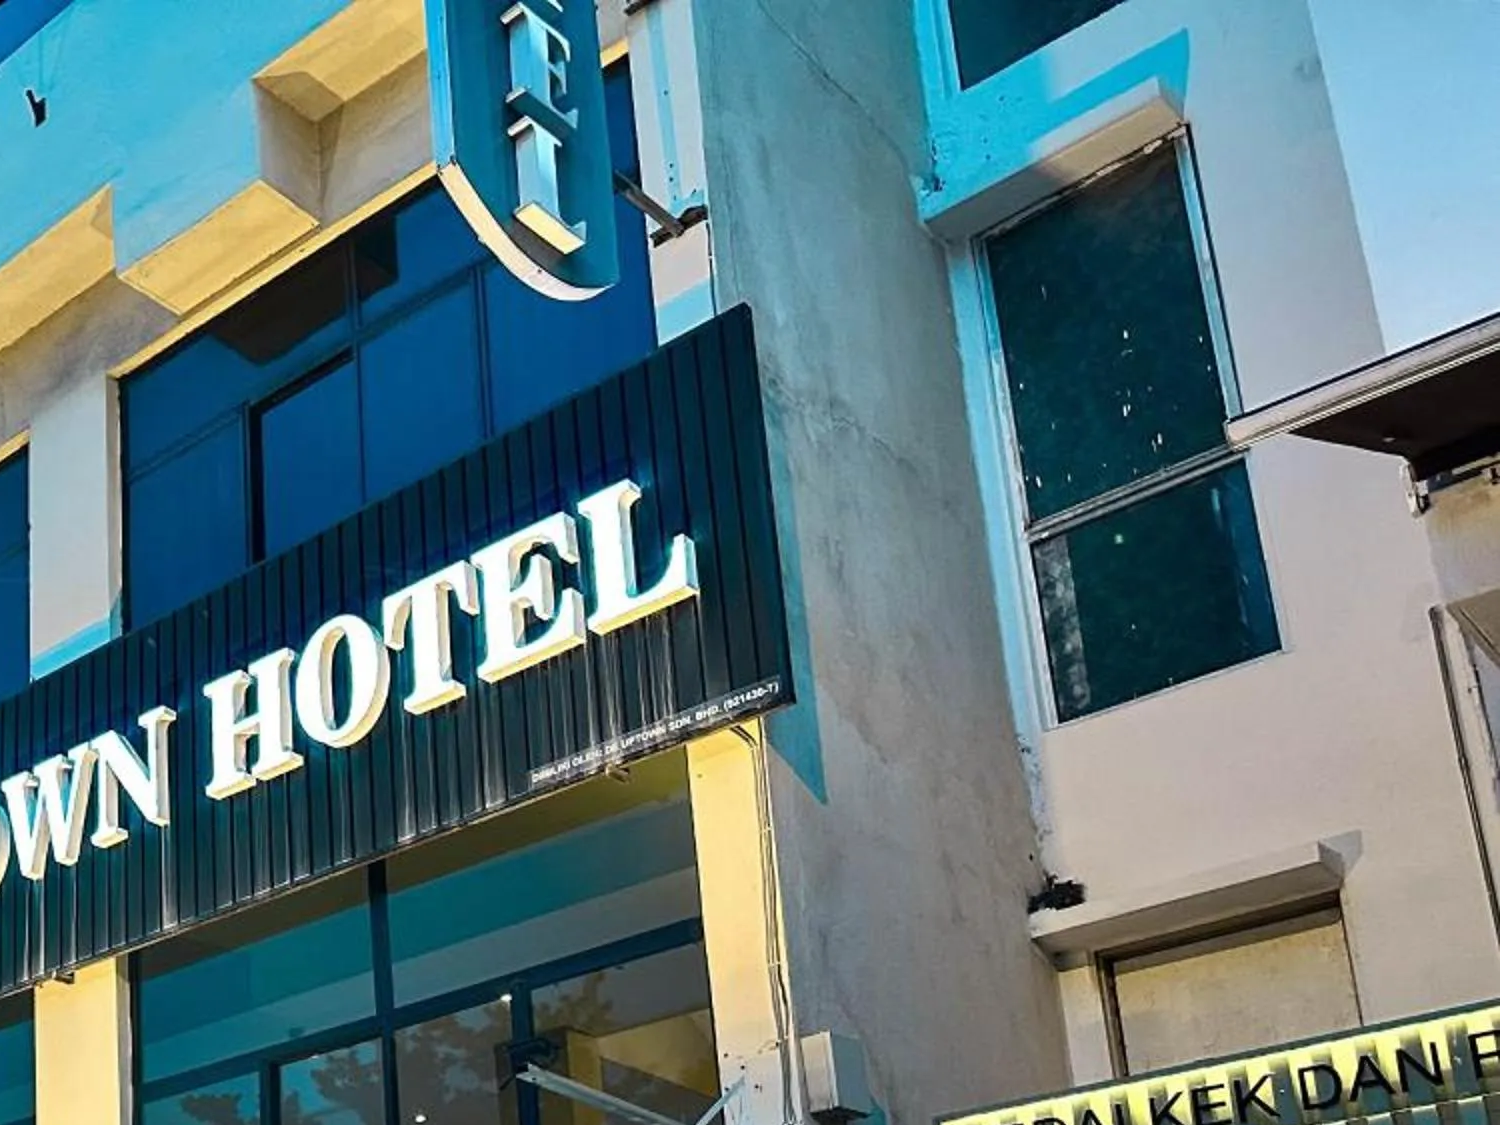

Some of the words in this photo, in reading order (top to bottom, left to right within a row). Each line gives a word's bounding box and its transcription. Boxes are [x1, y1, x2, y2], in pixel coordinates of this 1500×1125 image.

[500, 0, 587, 255] EL
[203, 478, 700, 800] HOTEL
[620, 726, 667, 748] UPTOWN
[1298, 1040, 1445, 1111] DAN
